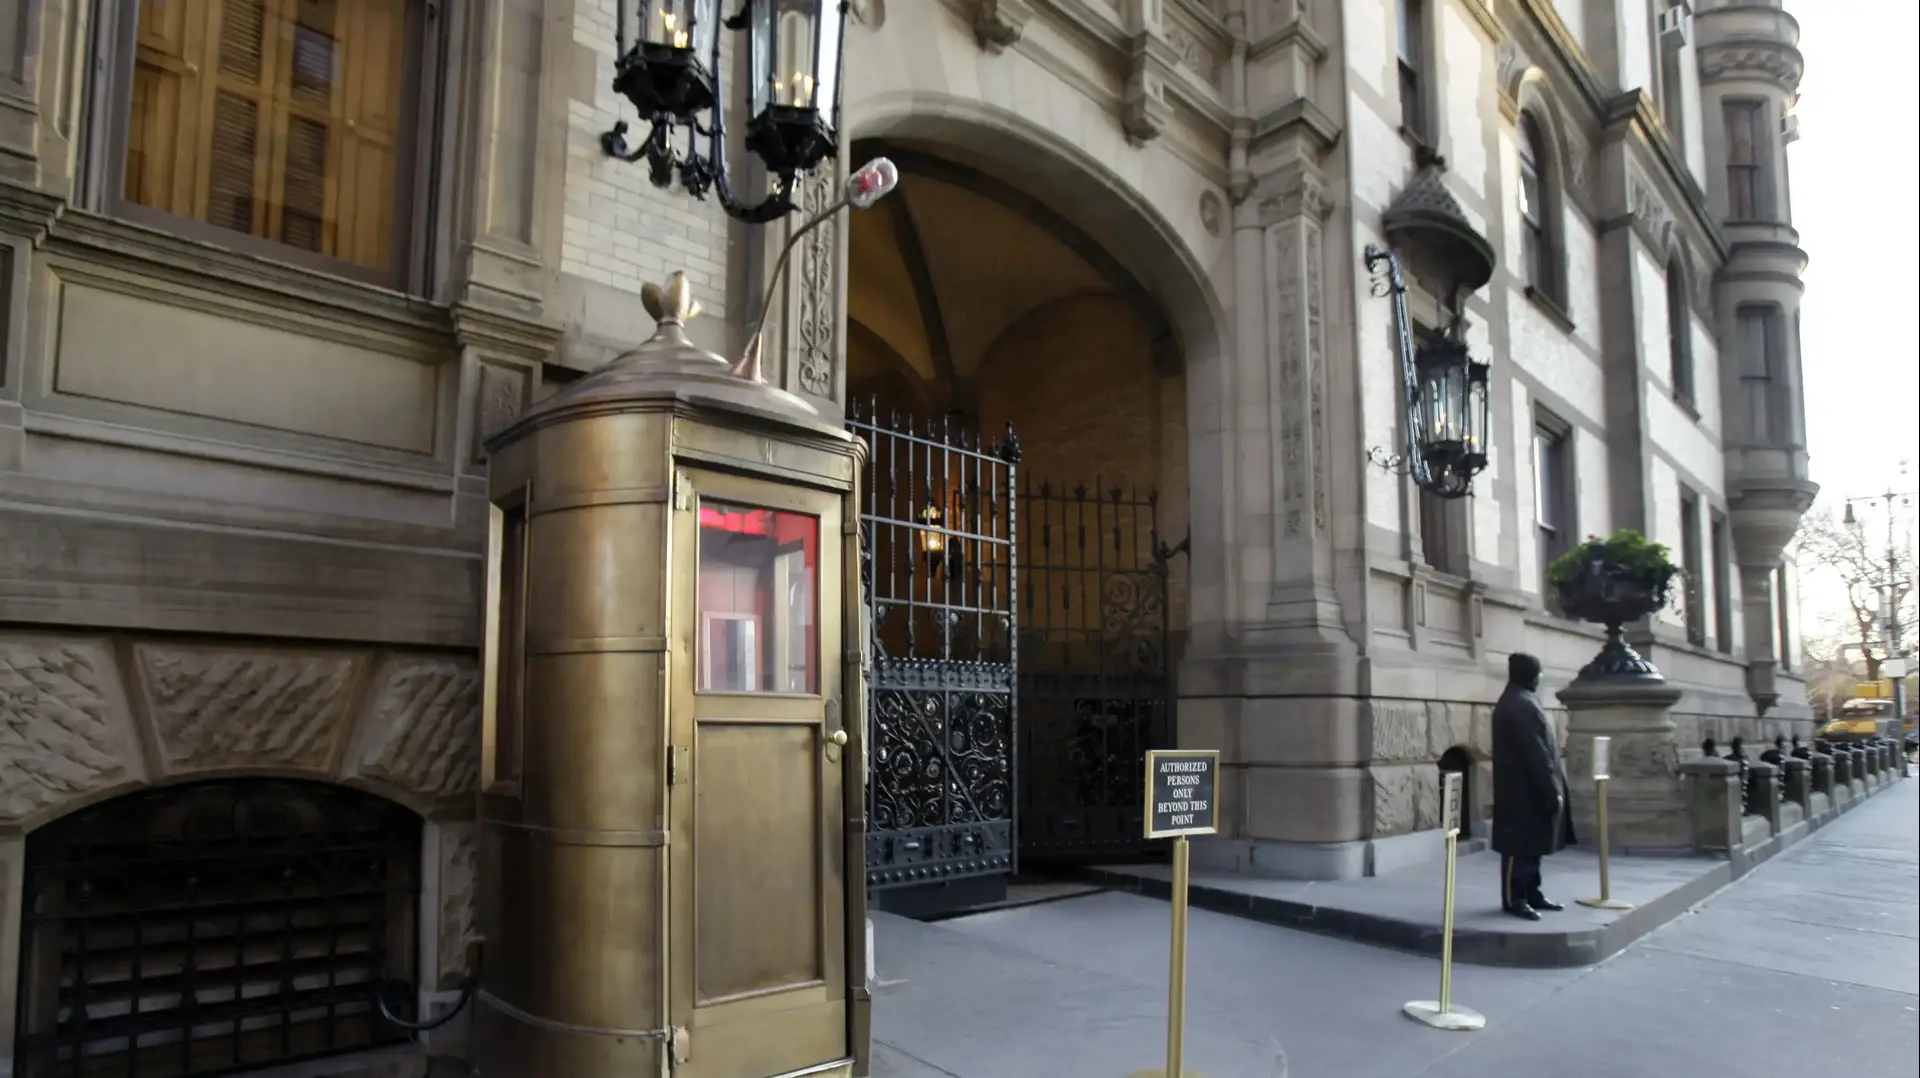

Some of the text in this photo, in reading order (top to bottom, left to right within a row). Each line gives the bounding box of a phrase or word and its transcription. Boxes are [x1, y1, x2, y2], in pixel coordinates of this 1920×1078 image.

[1160, 762, 1207, 773] AUTHORIZED
[1167, 775, 1200, 786] PERSONS
[1173, 788, 1193, 799] ONLY
[1158, 800, 1208, 813] BEYOND THIS
[1171, 814, 1194, 826] POINT
